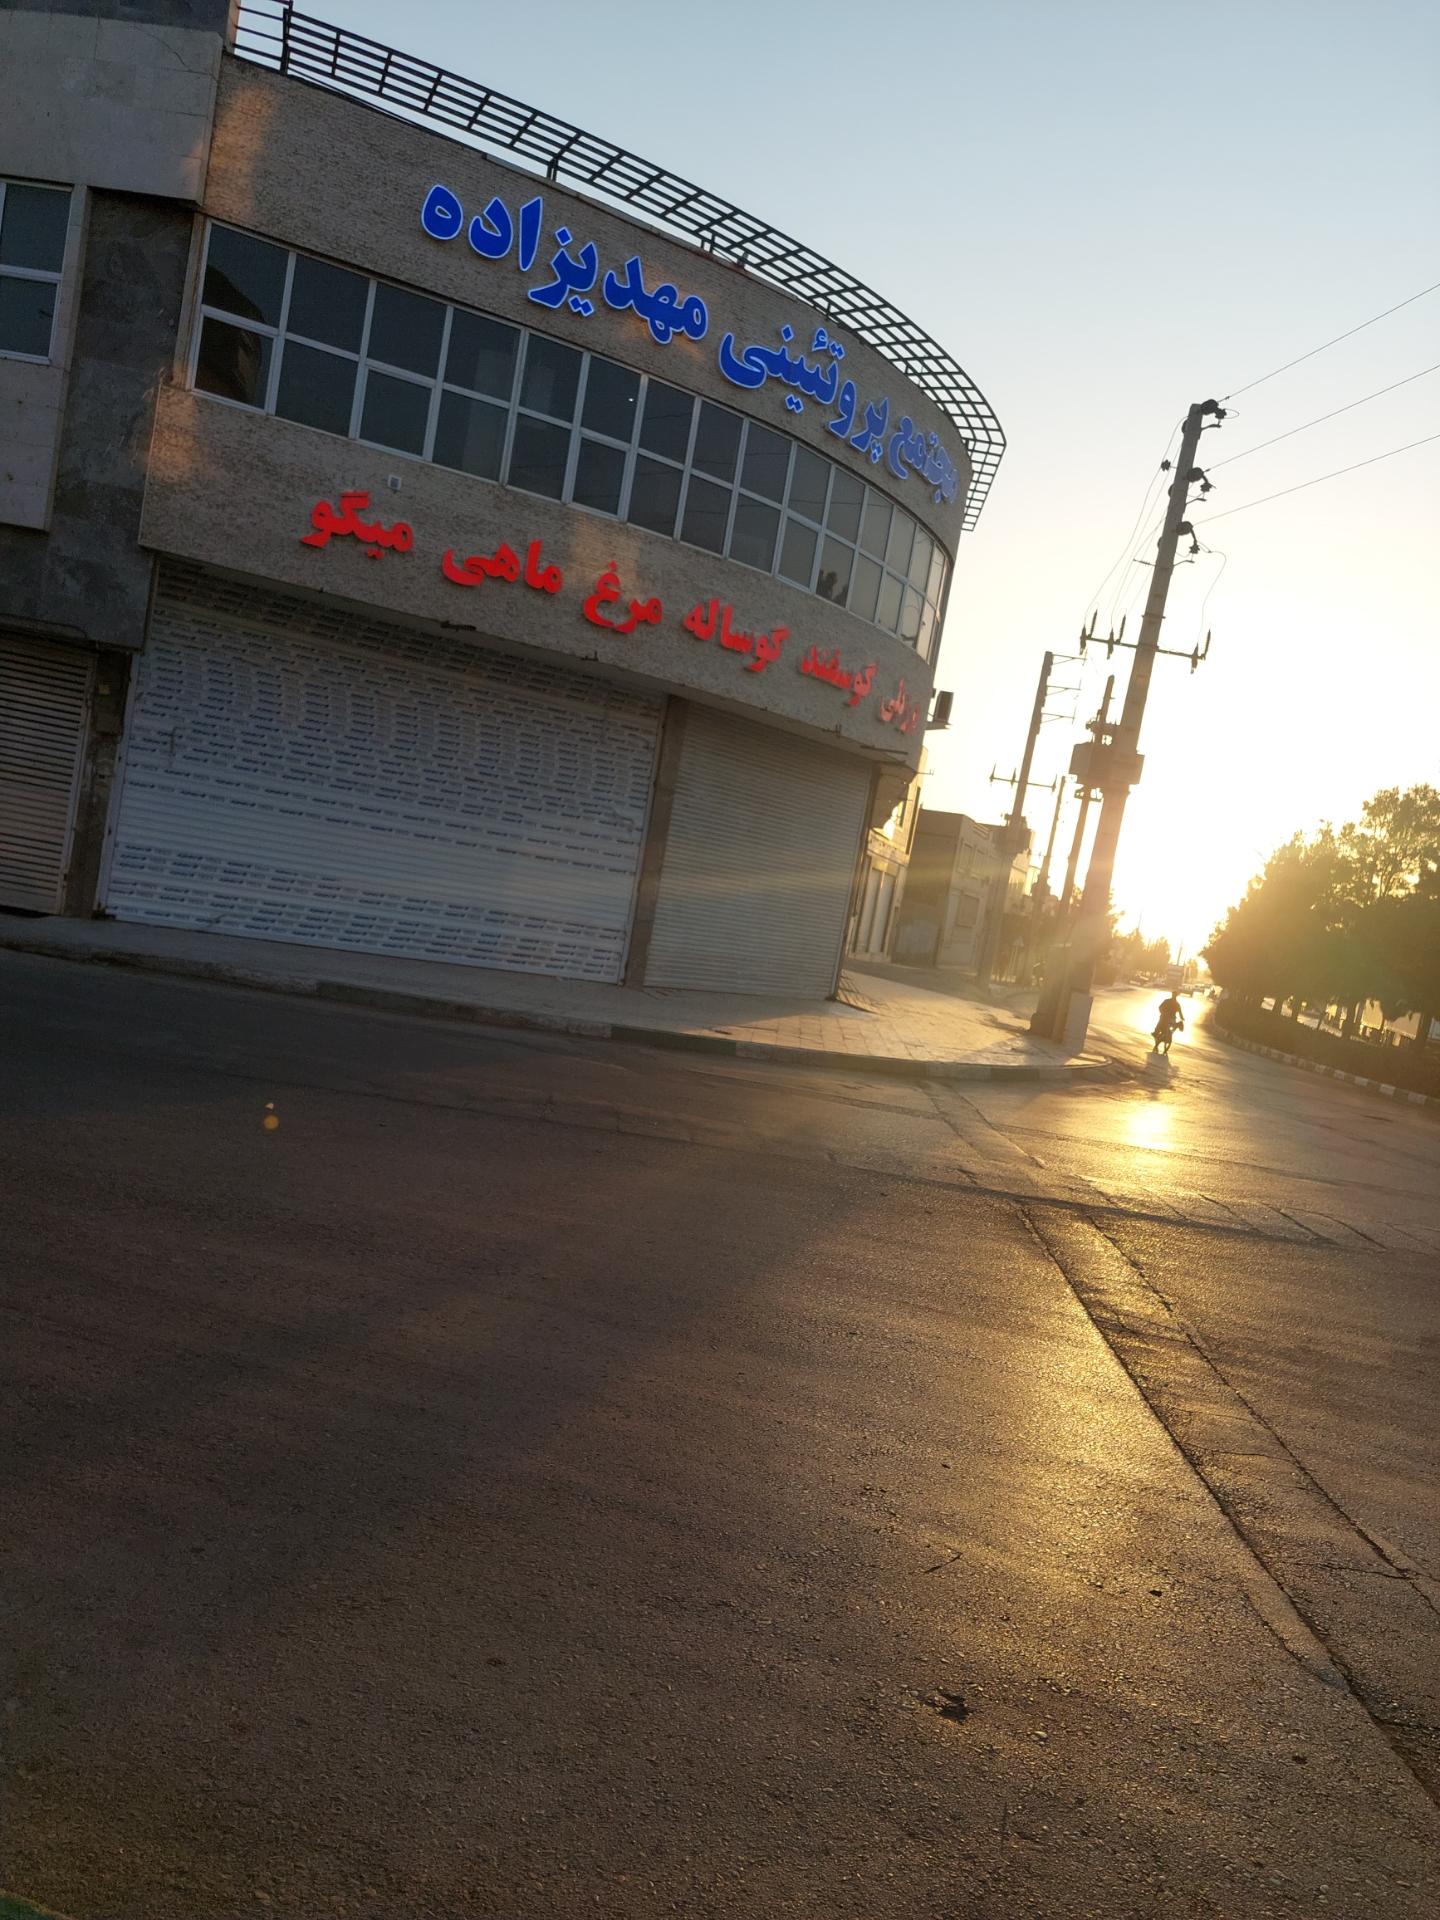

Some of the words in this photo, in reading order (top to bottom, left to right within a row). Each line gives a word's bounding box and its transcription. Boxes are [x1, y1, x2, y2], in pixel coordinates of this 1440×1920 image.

[420, 183, 709, 345] مهدیزاده
[719, 323, 890, 465] پروتئینی
[886, 414, 959, 504] مجتمع
[301, 490, 414, 560] میگو
[442, 538, 564, 594] ماهی
[582, 560, 664, 634] مرغ
[683, 598, 791, 673] گوساله
[801, 645, 877, 707] گوسفند
